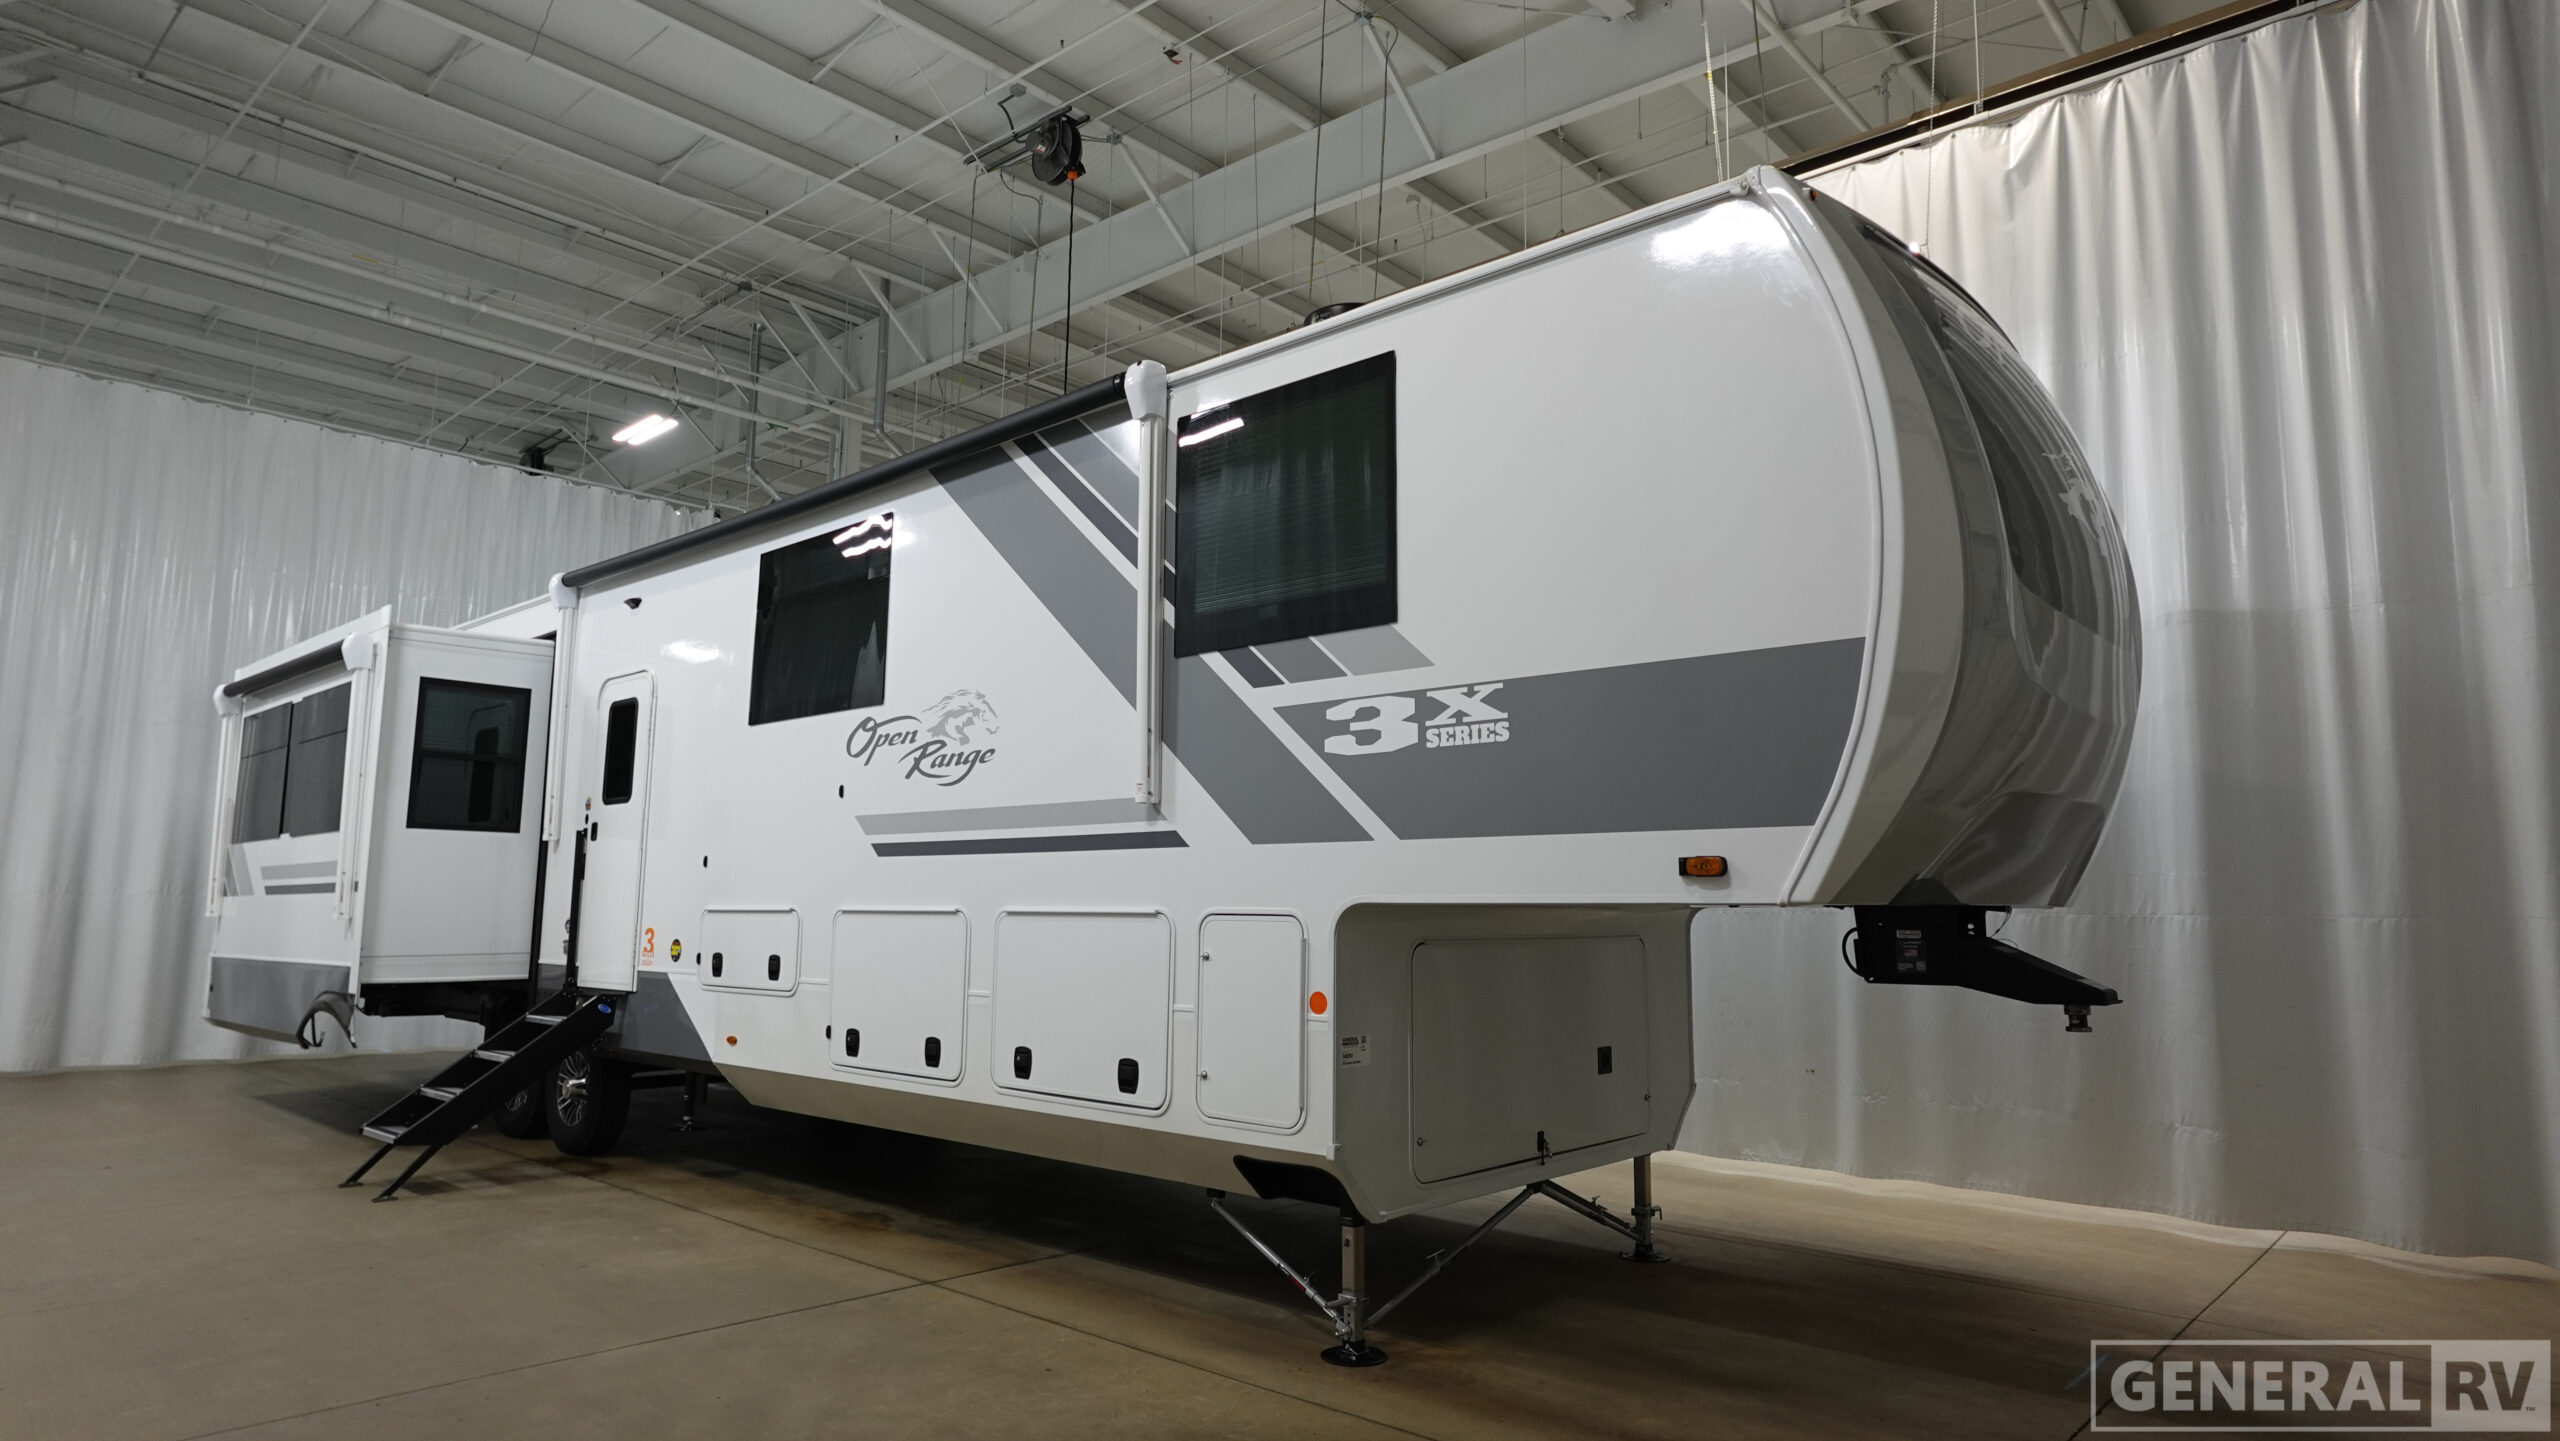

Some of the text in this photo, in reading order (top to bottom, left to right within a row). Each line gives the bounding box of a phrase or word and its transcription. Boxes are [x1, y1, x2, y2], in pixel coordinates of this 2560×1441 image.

[846, 715, 922, 766] Open
[1425, 721, 1510, 749] SERIES
[898, 739, 997, 787] Range
[643, 927, 655, 953] 3
